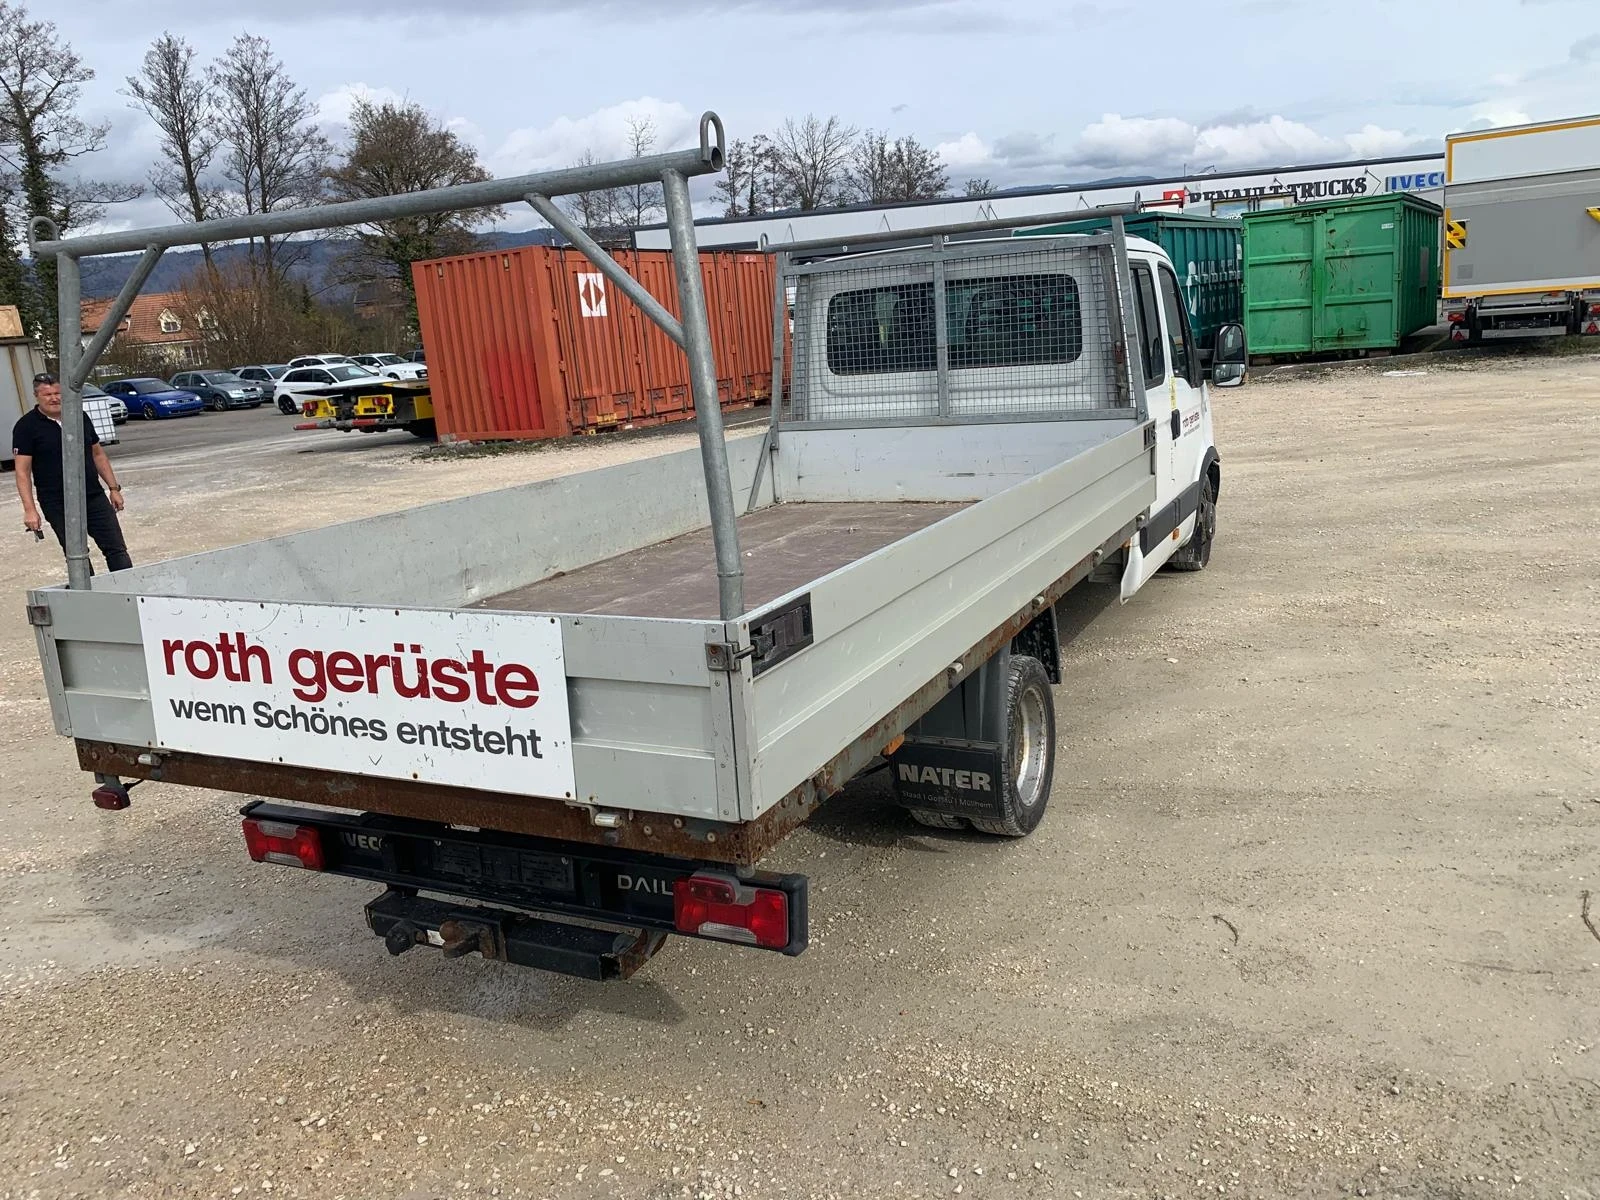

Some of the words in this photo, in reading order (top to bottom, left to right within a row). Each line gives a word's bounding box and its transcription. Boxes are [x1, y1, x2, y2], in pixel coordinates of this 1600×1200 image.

[1286, 177, 1367, 199] TRUCKS
[161, 632, 272, 684] roth
[288, 643, 540, 709] gerüste
[170, 698, 246, 725] wenn
[254, 700, 388, 741] Schönes
[396, 719, 543, 759] entsteht
[898, 763, 991, 792] NATER
[337, 830, 384, 852] IVEC
[617, 874, 674, 896] DAIL
